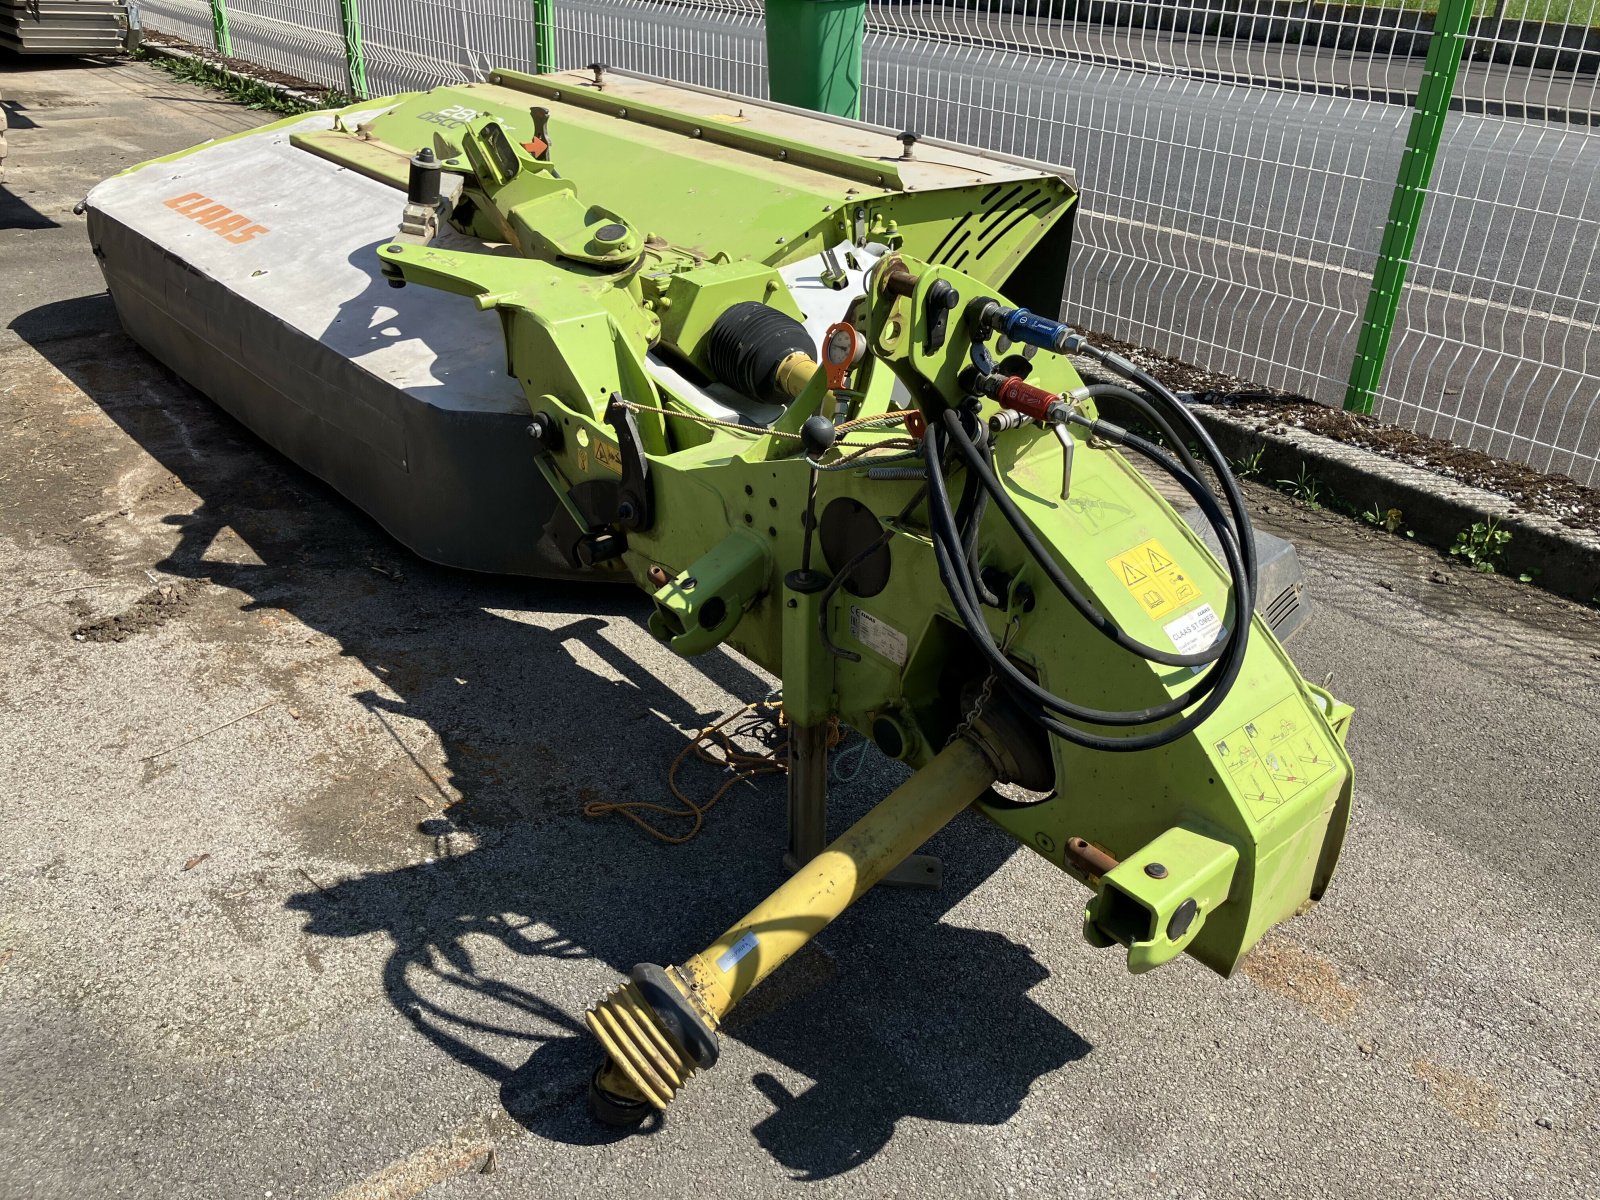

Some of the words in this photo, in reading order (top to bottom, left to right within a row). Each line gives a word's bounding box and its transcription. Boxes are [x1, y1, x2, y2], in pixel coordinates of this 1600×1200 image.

[162, 192, 271, 244] CLAAS
[1172, 626, 1192, 641] CLAAS
[1199, 613, 1215, 626] OMER
